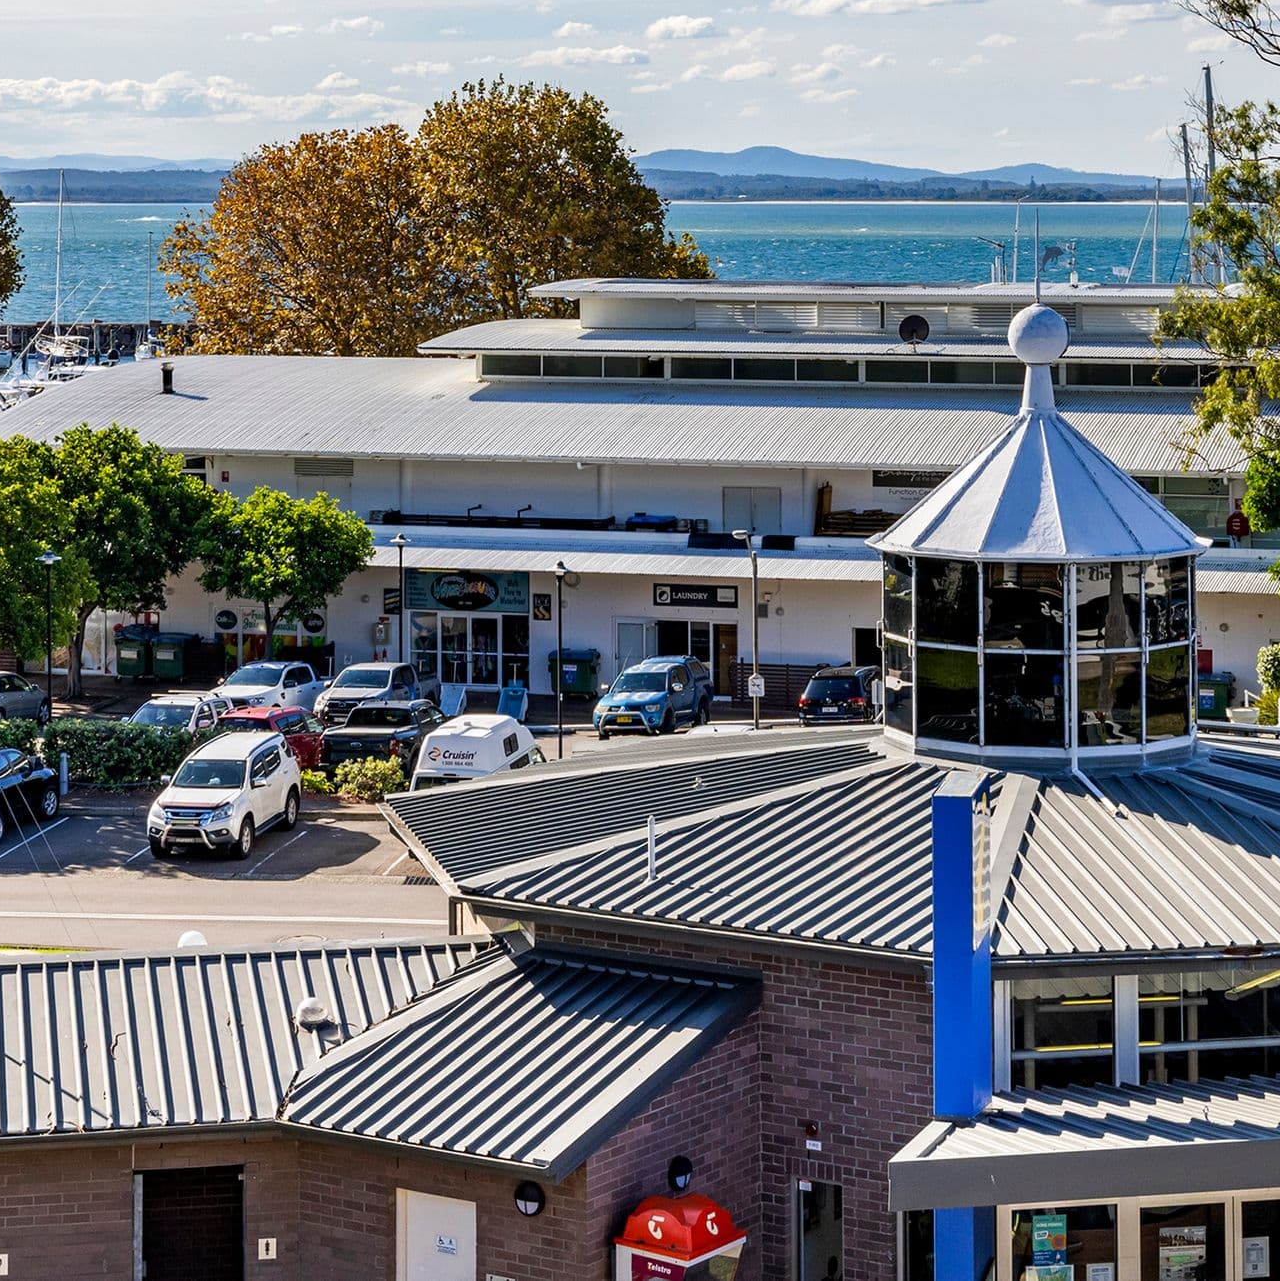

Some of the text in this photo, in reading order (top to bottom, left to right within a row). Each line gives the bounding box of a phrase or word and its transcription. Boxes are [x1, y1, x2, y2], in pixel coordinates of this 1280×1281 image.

[888, 488, 917, 496] Function
[672, 591, 708, 600] LAUNDRY
[442, 750, 478, 760] Cruisin'
[647, 1262, 672, 1275] Telstra
